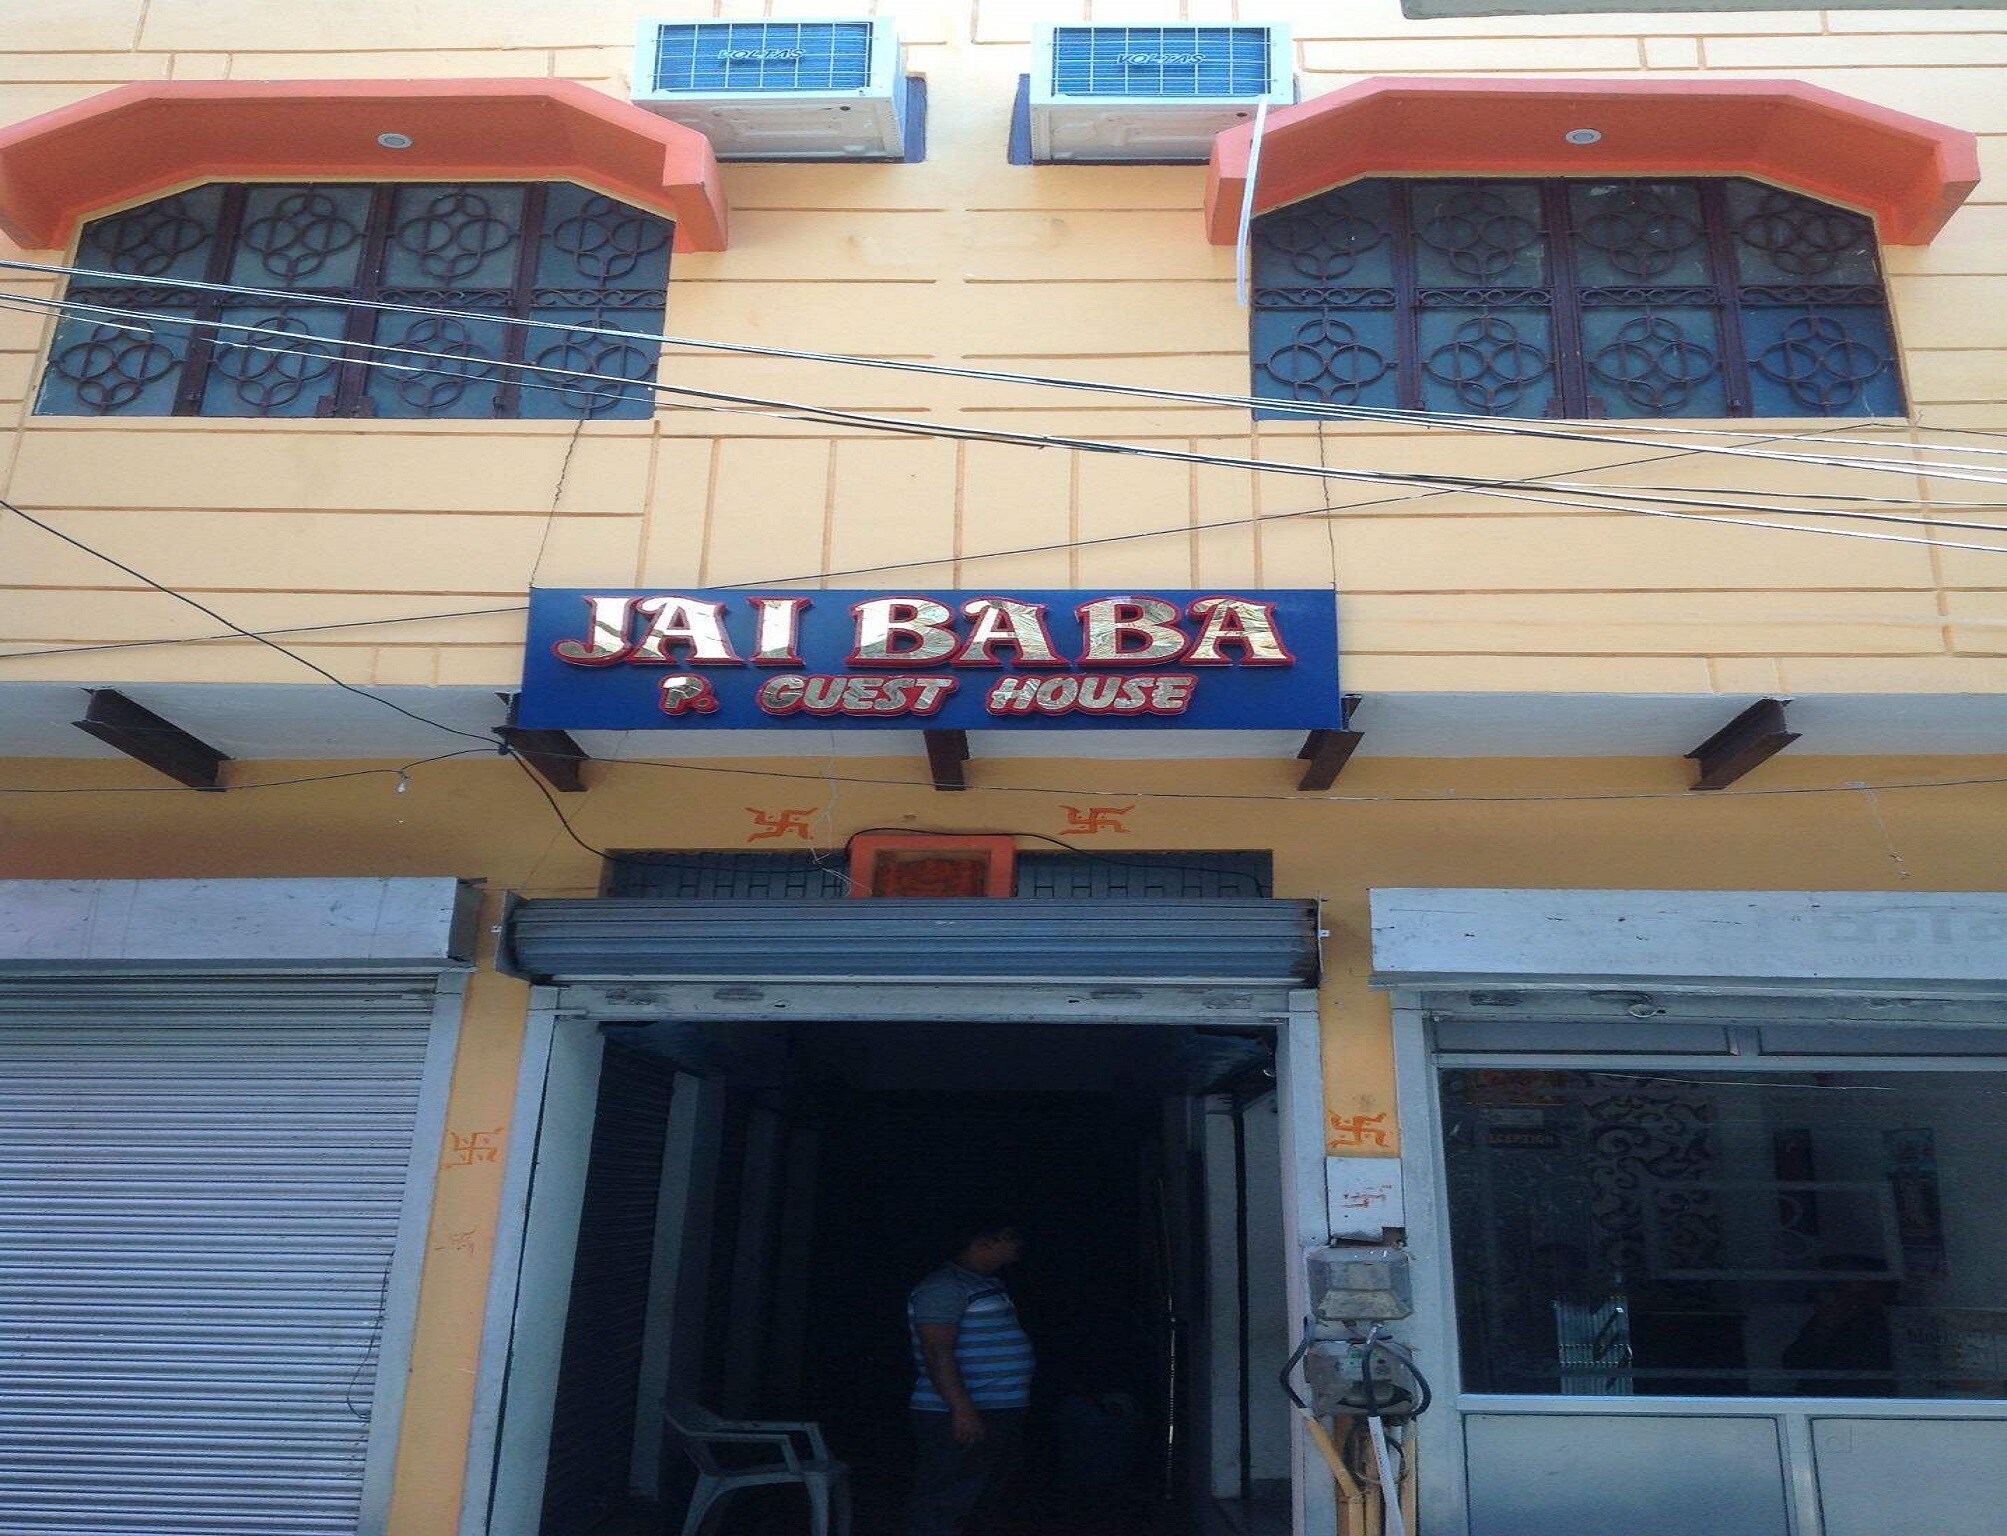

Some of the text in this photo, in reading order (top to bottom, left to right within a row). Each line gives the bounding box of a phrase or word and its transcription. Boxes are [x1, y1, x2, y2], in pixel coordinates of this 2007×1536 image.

[718, 48, 804, 60] VOLTAS
[1117, 53, 1206, 64] VOLTAS
[553, 595, 1294, 668] JAI BABA
[757, 674, 960, 716] GUEST
[986, 674, 1199, 716] HOUSE
